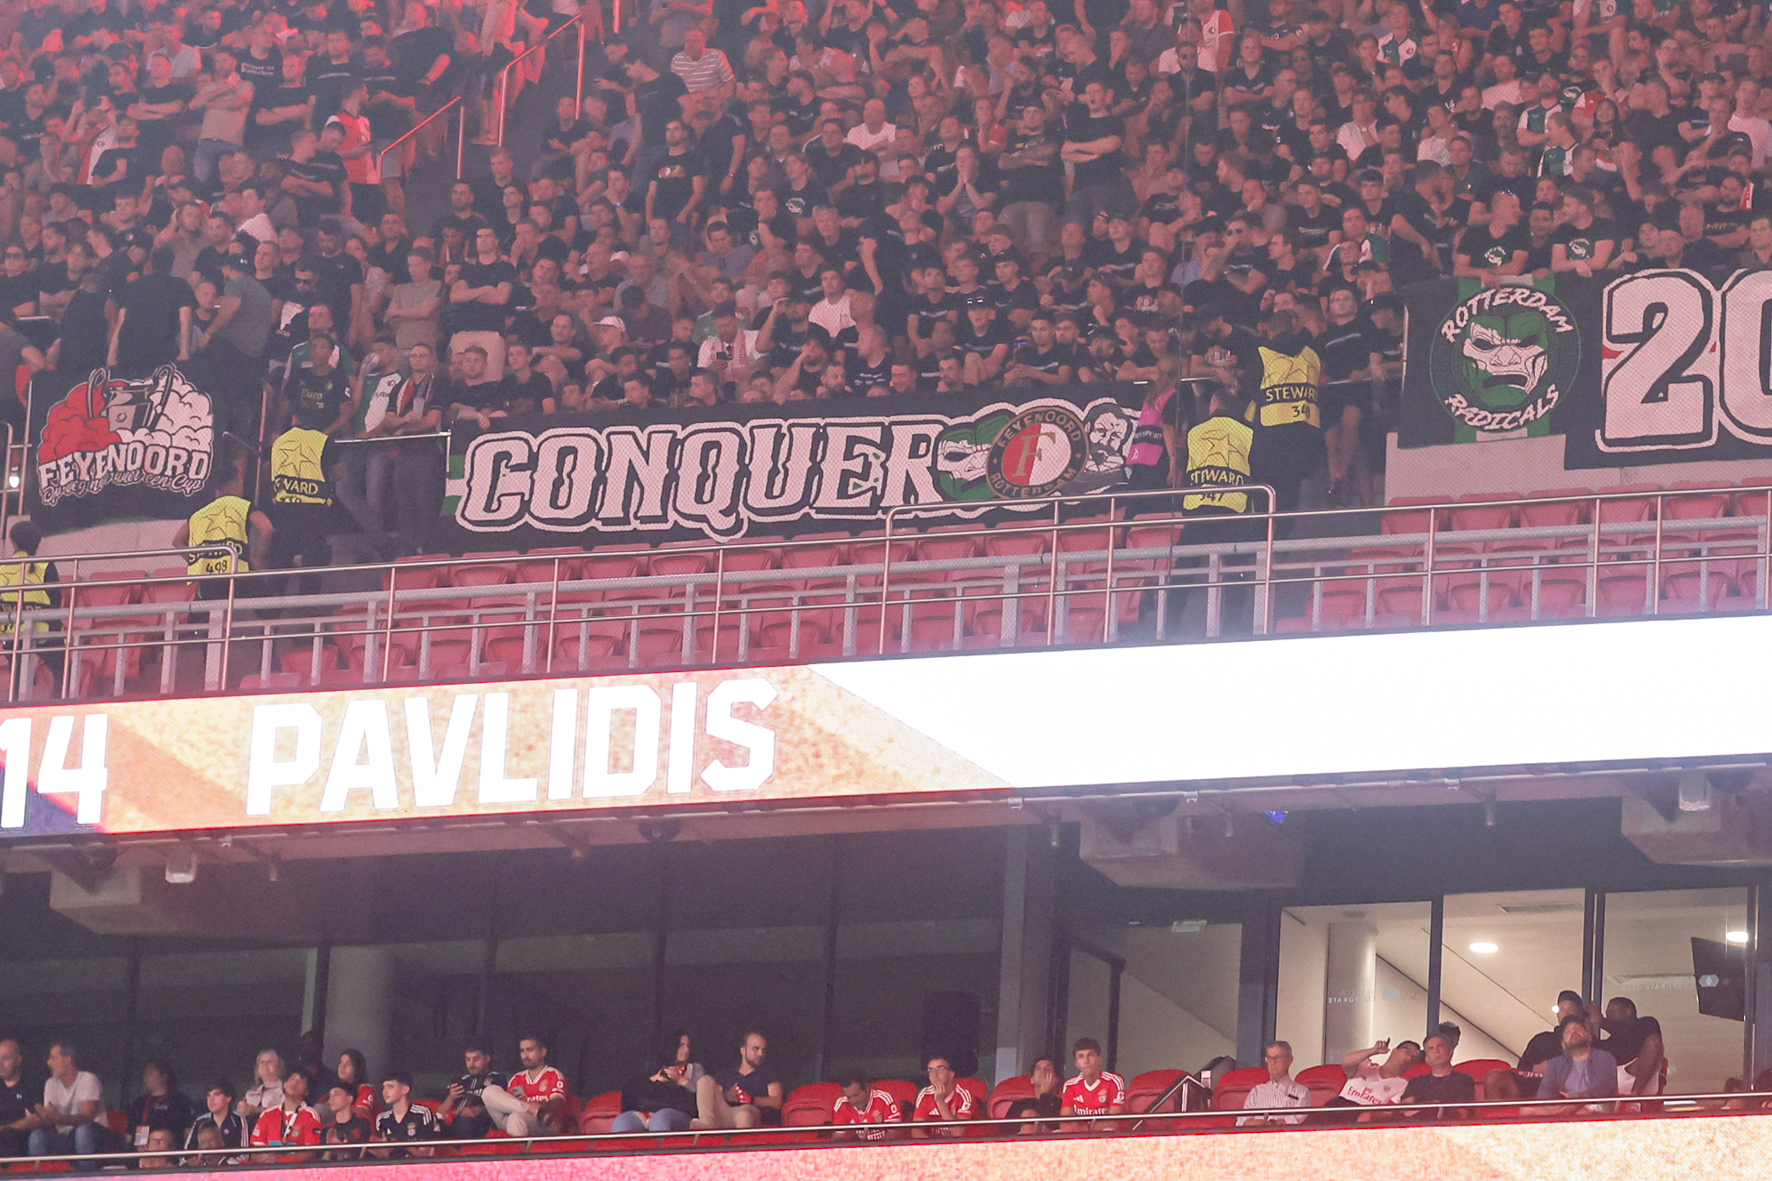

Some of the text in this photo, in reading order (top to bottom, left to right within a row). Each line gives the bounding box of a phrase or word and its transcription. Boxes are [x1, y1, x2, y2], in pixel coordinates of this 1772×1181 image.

[1441, 288, 1574, 344] ROTTERDAM
[1265, 387, 1318, 402] STEWAR
[1444, 384, 1560, 431] RADICALS
[996, 411, 1082, 448] FEYENOORD
[38, 443, 210, 489] FEYENOORD
[458, 419, 946, 539] CONQUER
[205, 559, 229, 574] 498
[0, 676, 779, 829] 14 PAVLIDIS
